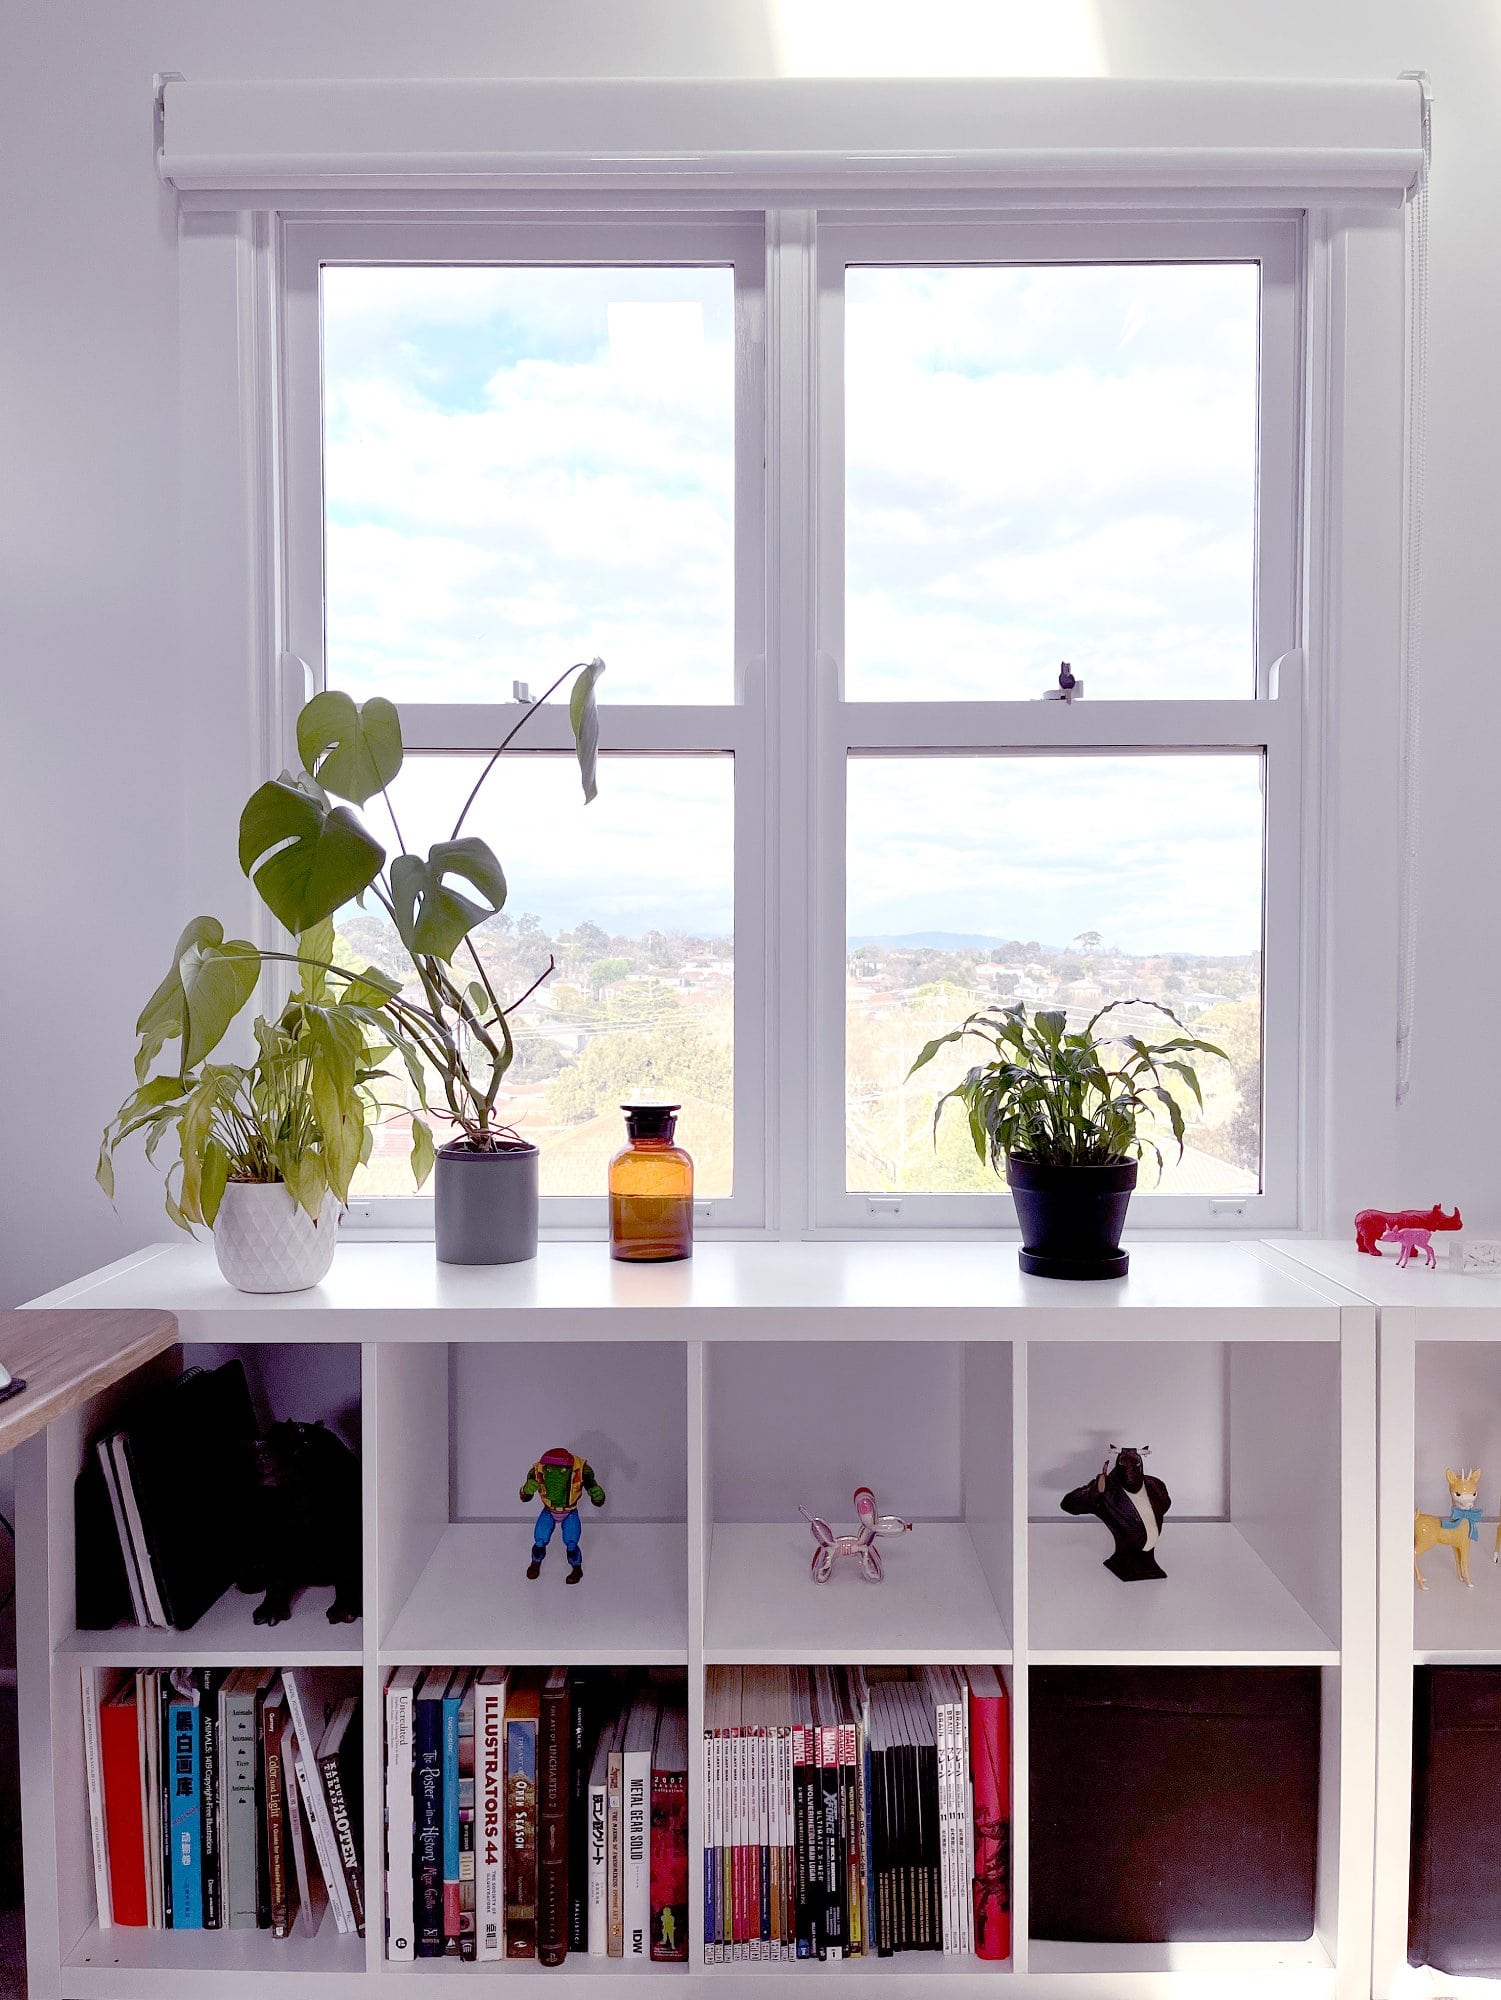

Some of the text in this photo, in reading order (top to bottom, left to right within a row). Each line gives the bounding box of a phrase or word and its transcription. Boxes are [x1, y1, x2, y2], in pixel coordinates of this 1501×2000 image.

[204, 1716, 212, 1753] ANIMALS:
[399, 1696, 409, 1745] Uncredited
[793, 1731, 804, 1763] MARVEL
[805, 1729, 814, 1762] MARVEL
[823, 1731, 836, 1765] MARVEL
[845, 1730, 855, 1764] MARVEL
[269, 1755, 279, 1778] Color
[485, 1696, 499, 1866] ILLUSTRATORS 44
[548, 1744, 557, 1799] UNCHARTED
[203, 1769, 214, 1817] Copyright-Free
[324, 1763, 340, 1811] TERADA
[330, 1761, 346, 1811] KATSUYA
[630, 1779, 644, 1807] METAL
[268, 1794, 281, 1817] Light
[419, 1749, 441, 1861] The Poster in History
[630, 1810, 644, 1833] GEAR
[958, 1812, 964, 1820] 11
[206, 1817, 214, 1855] Illustrations
[514, 1811, 528, 1849] SEASON
[630, 1835, 644, 1860] SOLID
[420, 1867, 438, 1885] Max
[632, 1929, 643, 1954] IDW
